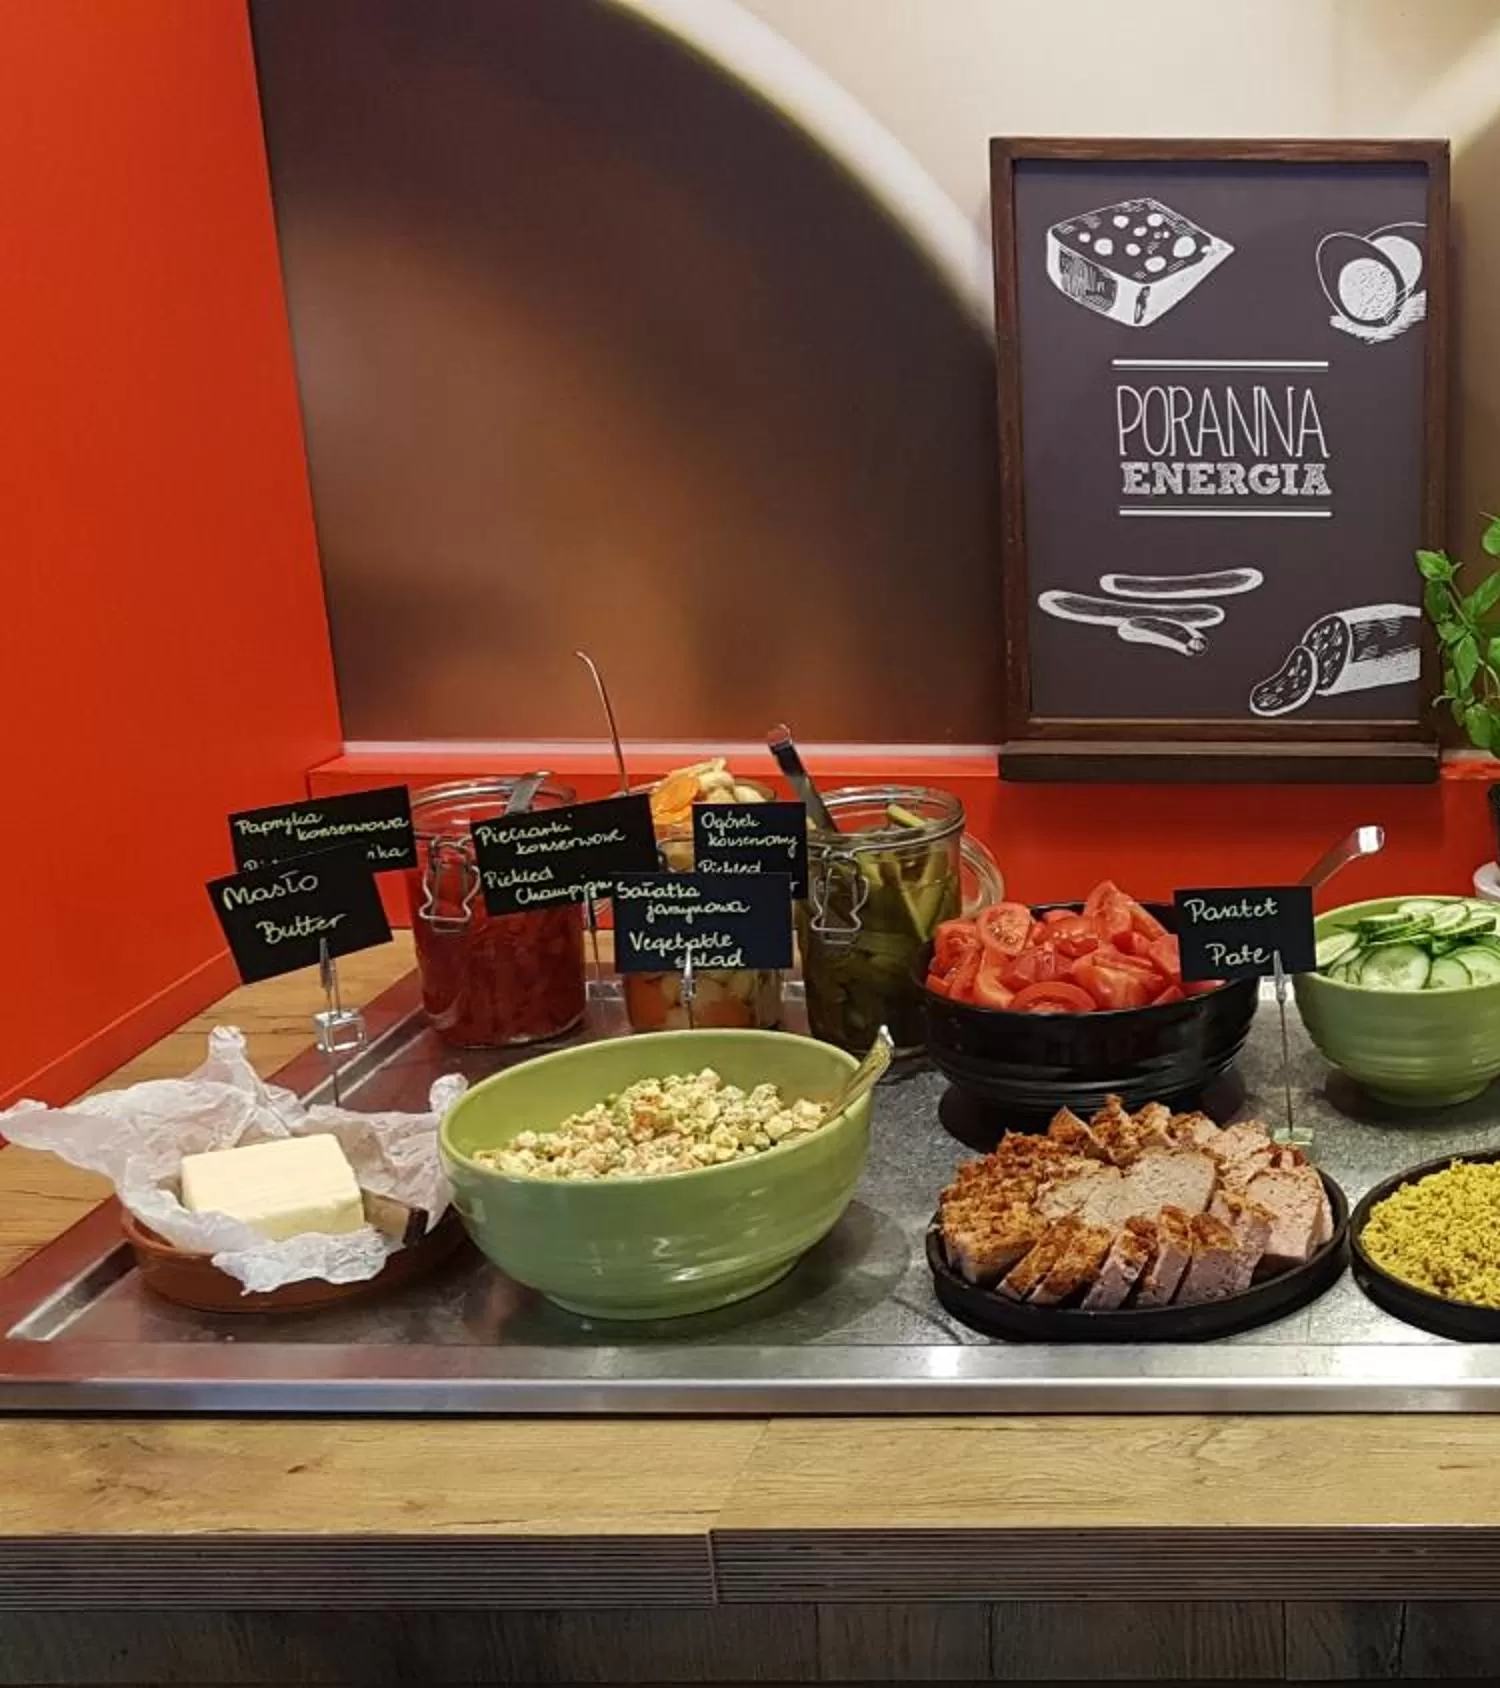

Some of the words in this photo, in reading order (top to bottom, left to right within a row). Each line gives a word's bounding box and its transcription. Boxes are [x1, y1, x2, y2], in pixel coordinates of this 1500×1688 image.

[1117, 385, 1331, 458] PORANNA
[1120, 461, 1332, 495] ENERGIA
[234, 811, 324, 836] Papryka
[296, 816, 409, 841] konserwowa
[701, 810, 761, 836] Ogórek
[483, 866, 554, 889] Pickled
[256, 913, 348, 944] Butter
[629, 932, 733, 957] Vegetable
[1204, 943, 1271, 966] Pate
[674, 948, 745, 968] salad
